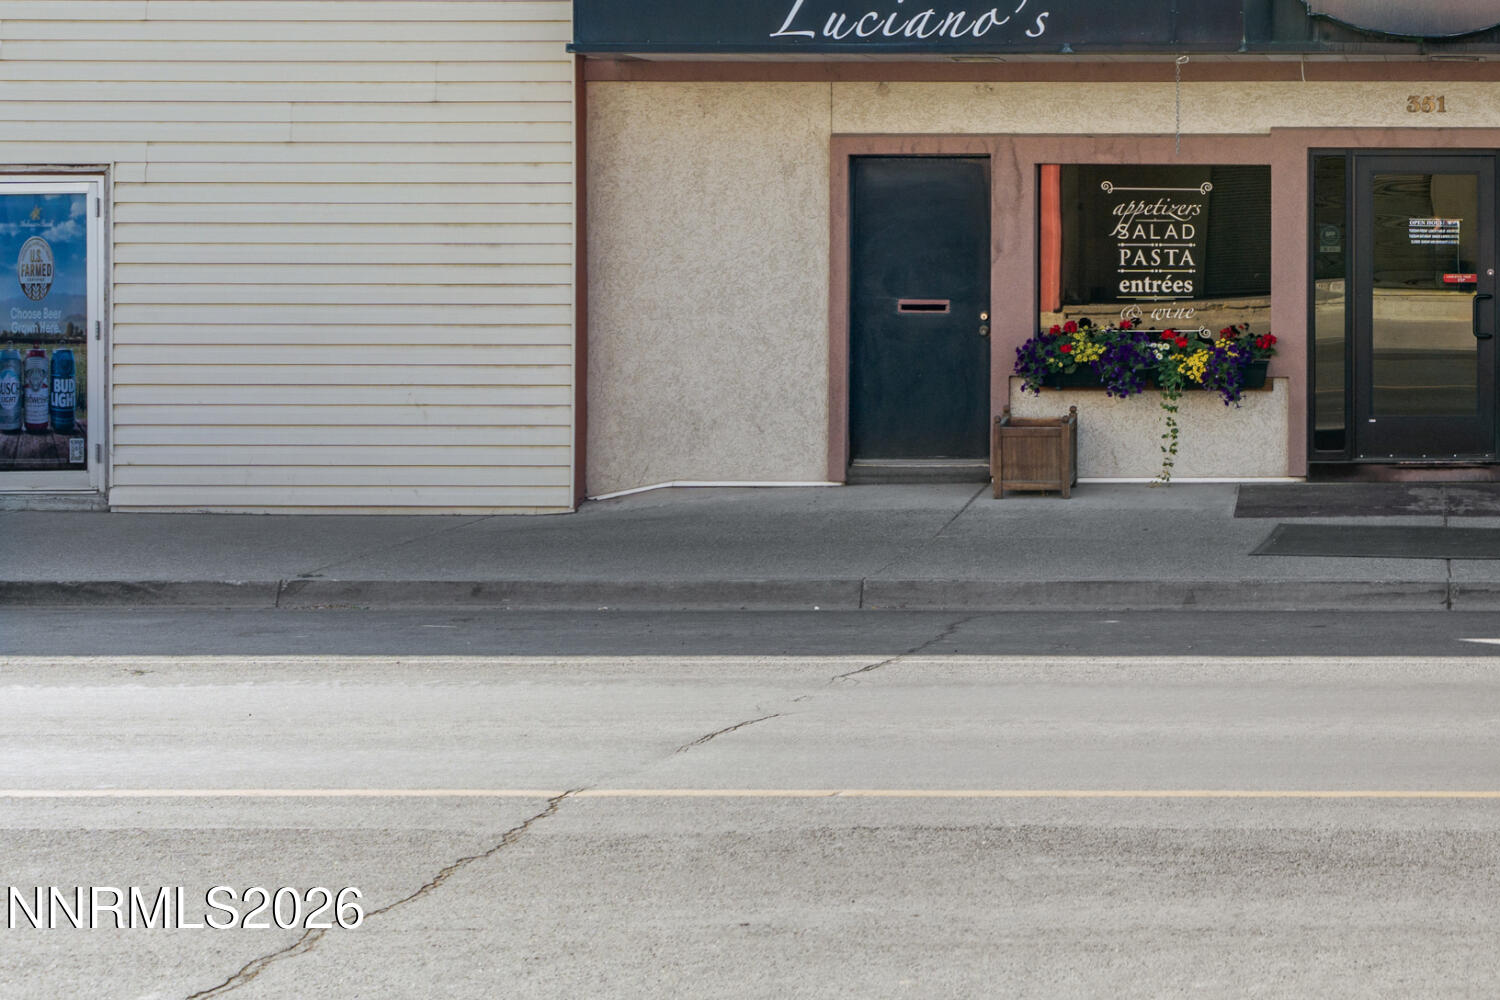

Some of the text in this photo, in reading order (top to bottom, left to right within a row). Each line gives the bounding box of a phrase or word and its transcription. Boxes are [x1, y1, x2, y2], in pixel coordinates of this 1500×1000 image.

[1407, 95, 1447, 113] 351
[1109, 198, 1202, 236] appetizers
[1117, 224, 1195, 239] SALAD
[30, 249, 43, 262] U.S.
[1119, 249, 1195, 266] PASTA
[21, 263, 52, 276] FARMED
[1119, 275, 1194, 293] entrées
[10, 307, 62, 320] Choose Beer
[1151, 302, 1195, 320] wine
[0, 382, 18, 395] USC
[53, 379, 75, 392] BUD
